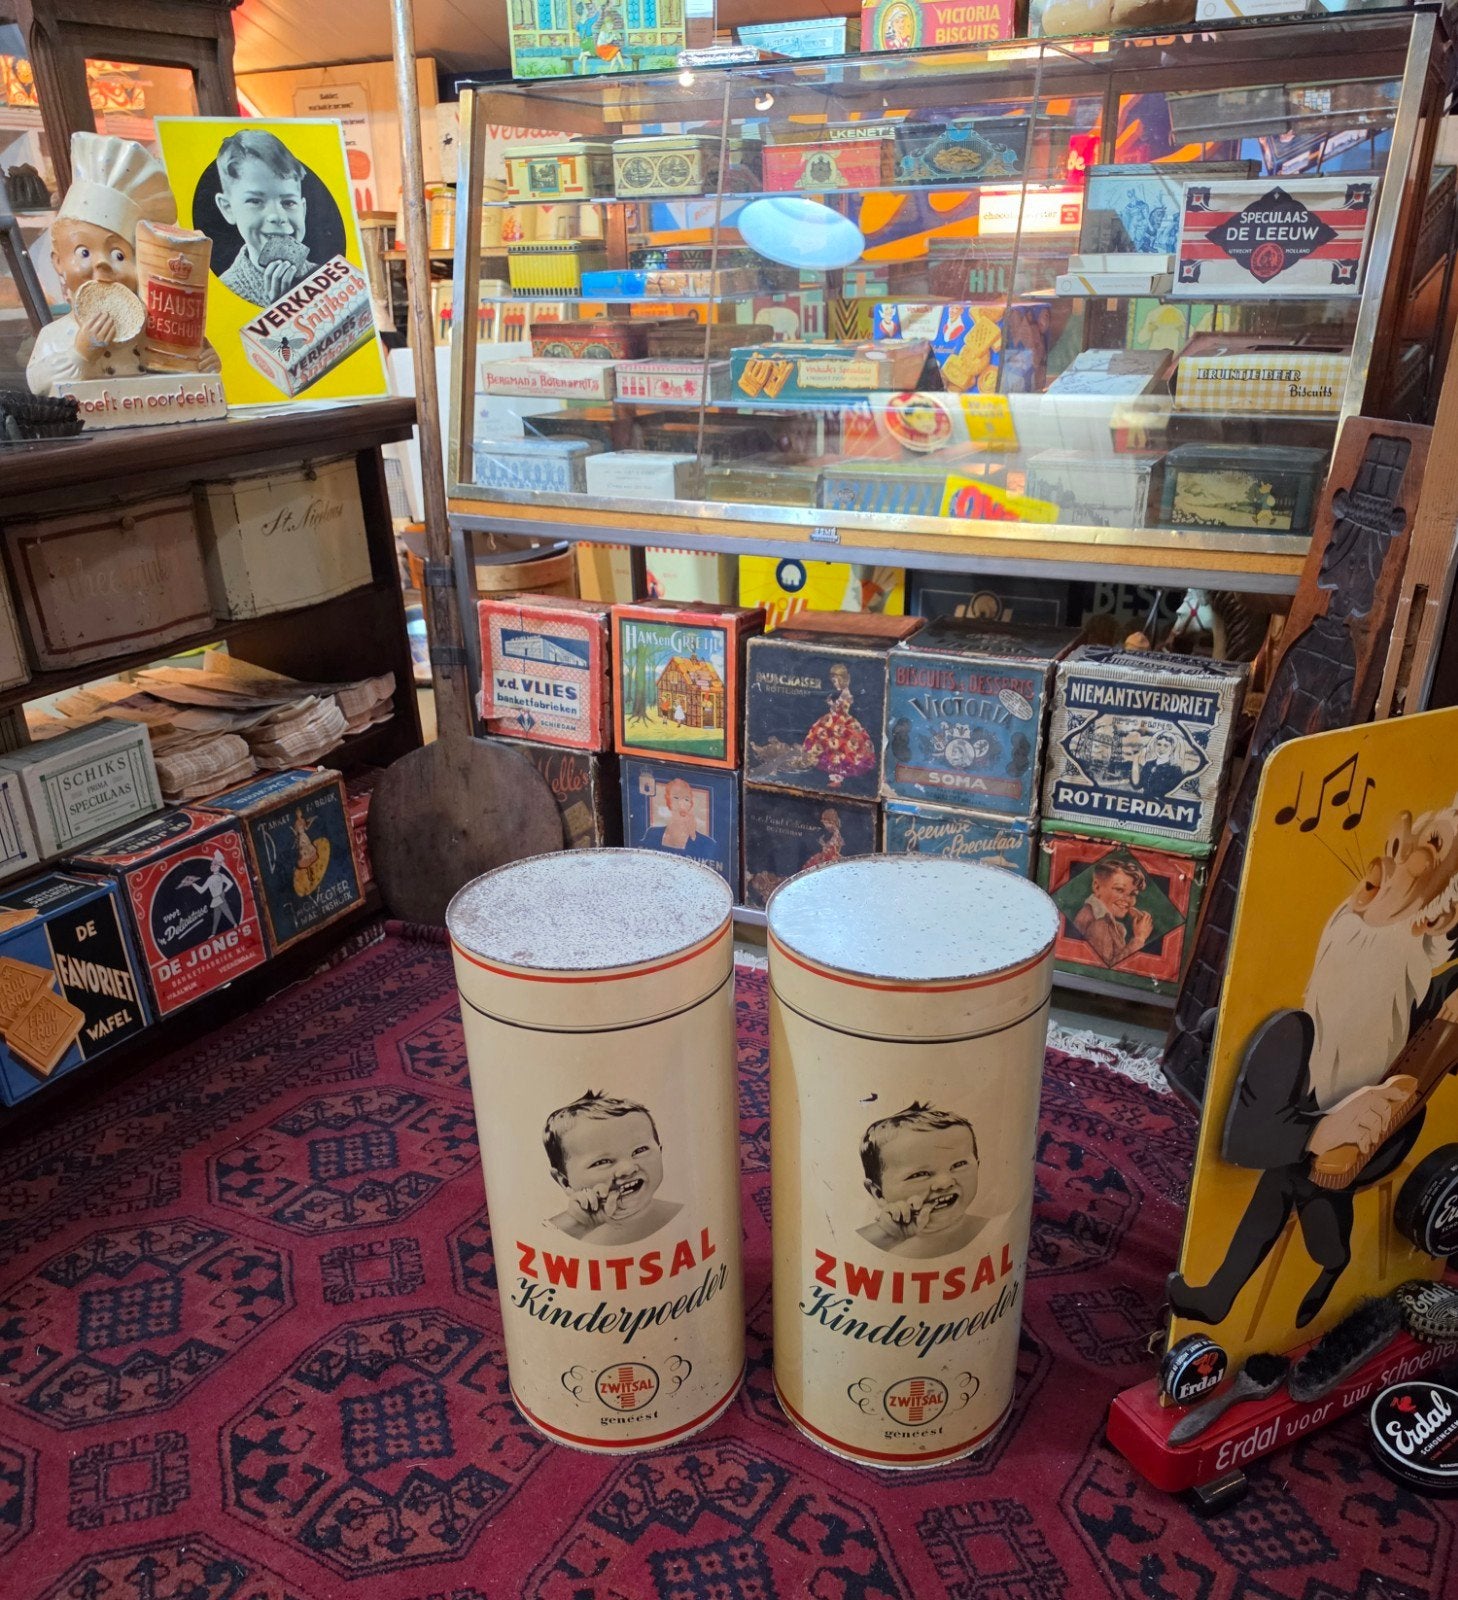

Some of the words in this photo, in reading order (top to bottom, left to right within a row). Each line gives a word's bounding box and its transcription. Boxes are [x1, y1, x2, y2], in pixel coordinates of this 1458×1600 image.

[940, 4, 1001, 24] VICTORIA
[936, 24, 999, 44] BISCUITS
[1240, 211, 1308, 224] SPECULAAS
[1226, 227, 1250, 241] DE
[1256, 226, 1319, 241] LEEUW
[248, 261, 350, 337] VERKADE'S
[1197, 368, 1261, 381] BRUINTJE
[1262, 368, 1301, 382] BEER
[123, 398, 144, 409] en
[1288, 384, 1333, 397] Biscuits
[496, 678, 519, 691] v.d.
[520, 678, 578, 700] VLIES
[895, 666, 955, 691] BISCUITS
[969, 674, 1035, 700] DESSERTS
[497, 692, 577, 715] banketfabrieken
[1070, 682, 1214, 717] NIEMANTSVERDRIET
[540, 720, 577, 731] SCHIEDAM
[62, 757, 127, 791] SCHIKS
[928, 771, 988, 791] SOMA
[69, 783, 132, 816] SPECULAAS
[1058, 787, 1195, 823] ROTTERDAM
[75, 919, 97, 942] DE
[157, 959, 183, 982] DE
[186, 924, 252, 968] JONG'S
[56, 952, 134, 1002] FAVORIET
[171, 952, 233, 988] BANKETFABRIEK
[29, 1009, 57, 1028] FROU
[85, 1008, 133, 1042] WAFEL
[29, 1024, 58, 1043] FROU
[516, 1226, 716, 1291] ZWITSAL
[815, 1243, 1014, 1304] ZWITSAL
[511, 1262, 729, 1344] Kinderpoeder
[1404, 1282, 1456, 1315] Erdal
[799, 1279, 1022, 1359] Kinderpoeder
[600, 1379, 655, 1395] ZWITSAL
[1178, 1367, 1224, 1400] Erdal
[889, 1391, 944, 1408] ZWITSAL
[600, 1410, 659, 1426] geneest
[1215, 1416, 1281, 1471] Erdal
[1285, 1402, 1334, 1437] voor
[1342, 1381, 1373, 1409] uw
[1385, 1389, 1452, 1455] Erdal
[884, 1426, 944, 1440] geneest
